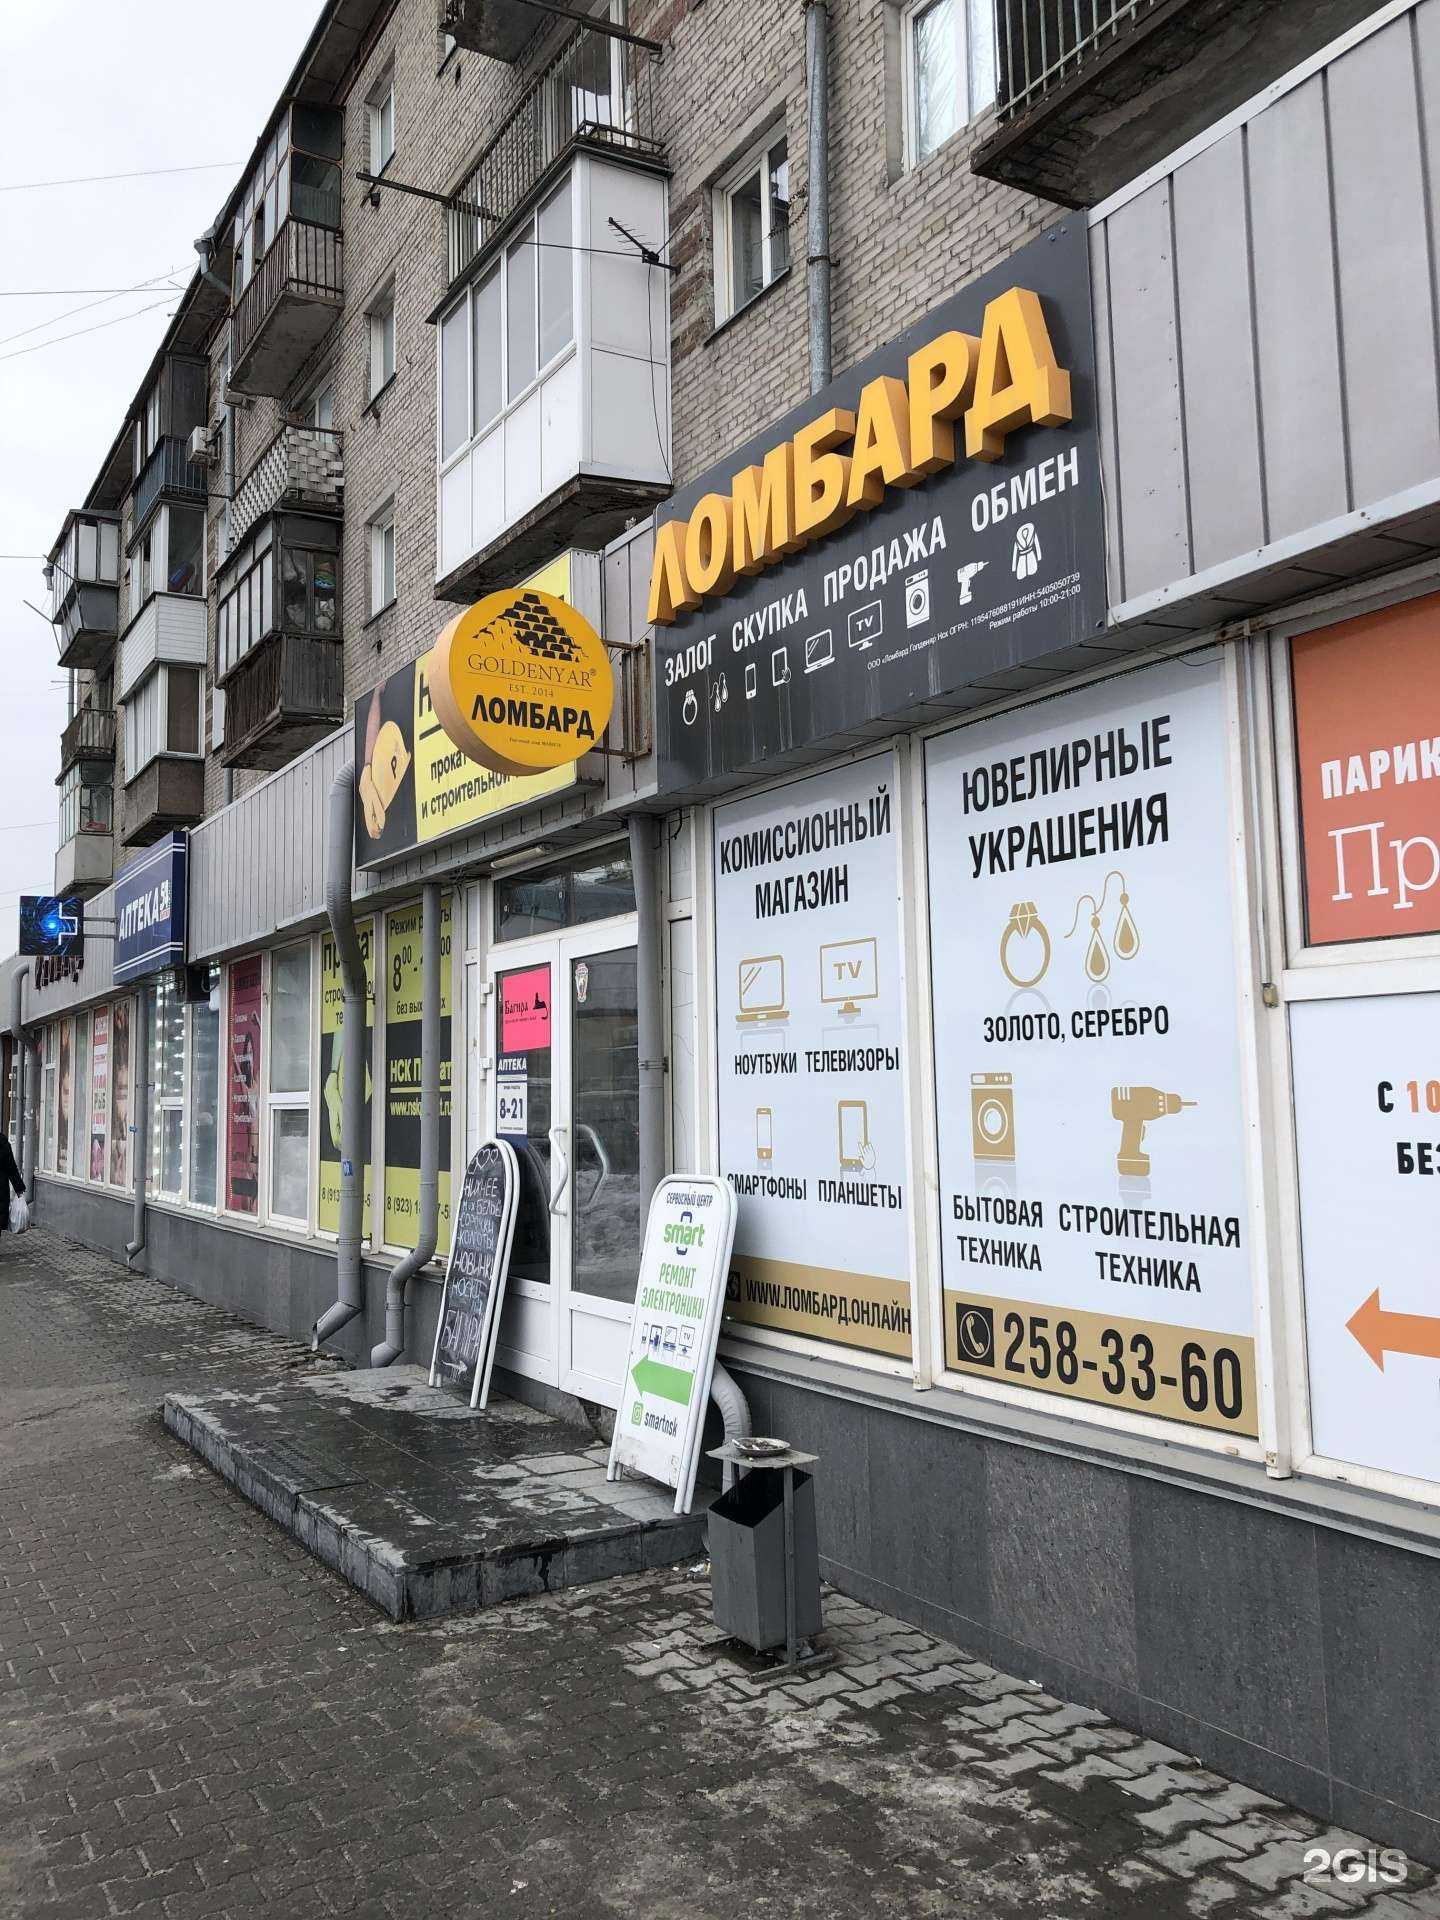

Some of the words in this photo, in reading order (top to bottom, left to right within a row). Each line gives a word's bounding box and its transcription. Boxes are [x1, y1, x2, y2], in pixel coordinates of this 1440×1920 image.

[648, 287, 1072, 626] ЛОМБАРД
[665, 635, 717, 687] ЗАЛОГ
[732, 588, 809, 653] СКУПКА
[823, 515, 947, 607] ПРОДАЖА
[971, 446, 1079, 533] ОБМЕН
[856, 615, 873, 631] TV
[1012, 605, 1038, 624] работы
[867, 658, 881, 671] ООО
[471, 695, 595, 740] ЛОМБАРД
[962, 715, 1172, 814] ЮВЕЛИРНЫЕ
[720, 784, 891, 875] КОМИССИОННЫЙ
[968, 792, 1169, 879] УКРАШЕНИЯ
[1328, 821, 1440, 910] Пр
[755, 864, 849, 920] МАГАЗИН
[119, 887, 160, 943] АПТЕКА
[390, 918, 416, 937] Режим
[832, 960, 862, 980] TV
[396, 1000, 407, 1016] без
[504, 1000, 529, 1017] Багира
[984, 1012, 1065, 1043] ЗОЛОТО,
[1071, 1005, 1169, 1039] СЕРЕБРО
[390, 1059, 411, 1083] НСК
[497, 1058, 527, 1071] АПТЕКА
[734, 1052, 797, 1075] НОУТБУКИ
[805, 1047, 899, 1073] ТЕЛЕВИЗОРЫ
[499, 1098, 523, 1119] 8-21
[1377, 1081, 1394, 1114] С
[818, 1180, 902, 1209] ПЛАНШЕТЫ
[664, 1223, 705, 1248] smart
[953, 1194, 1043, 1229] БЫТОВАЯ
[1059, 1203, 1241, 1248] СТРОИТЕЛЬНАЯ
[659, 1262, 697, 1289] РЕМОНТ
[957, 1235, 1042, 1271] ТЕХНИКА
[1095, 1251, 1201, 1293] ТЕХНИКА
[641, 1287, 705, 1320] ЭЛЕКТРОНИКИ
[746, 1280, 911, 1334] WWW.ЛОМБАРД.ОНЛАЙН
[1003, 1312, 1243, 1420] 258-33-60
[644, 1411, 678, 1438] smartnsk
